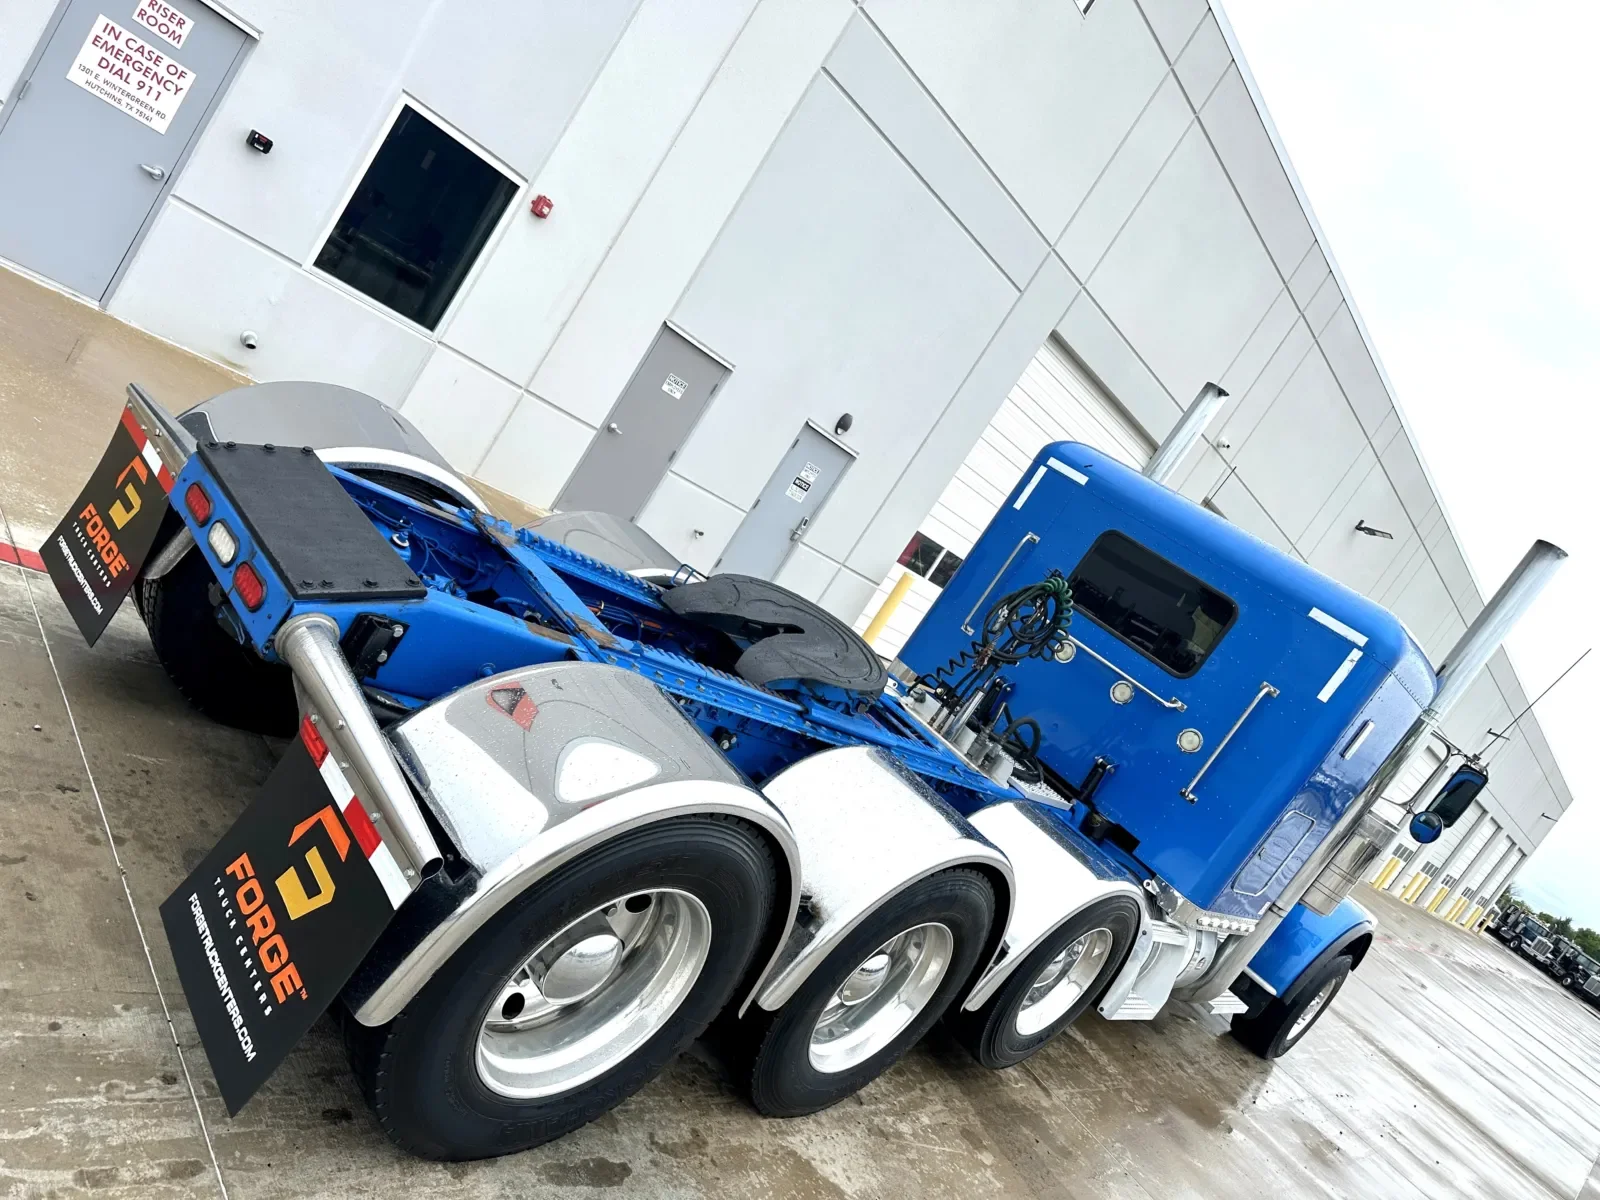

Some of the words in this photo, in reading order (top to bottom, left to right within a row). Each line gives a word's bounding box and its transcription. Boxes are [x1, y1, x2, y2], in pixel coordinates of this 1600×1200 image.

[136, 9, 182, 45] ROOM
[147, 0, 186, 30] RISER
[91, 35, 183, 96] EMERGENCY
[97, 57, 131, 85] DIAL
[136, 80, 162, 101] 911
[102, 22, 121, 42] IN
[125, 37, 164, 67] CASE
[166, 62, 188, 81] OF
[78, 63, 94, 77] 1301
[94, 73, 102, 82] E.
[102, 78, 155, 114] WINTERGREEN
[155, 109, 167, 121] RD.
[85, 79, 123, 107] HUTCHINS,
[124, 102, 134, 112] TX
[135, 108, 153, 123] 75141
[72, 521, 88, 548] TRUCK
[87, 548, 111, 588] CENTERS
[79, 502, 127, 578] FORGE
[57, 535, 104, 615] FORGETRUCKCENTERS.COM
[214, 877, 237, 929] TRUCK
[235, 935, 272, 1017] CENTERS
[225, 852, 303, 1004] FORGE
[188, 892, 257, 1063] FORGETRUCKCENTERS.COM
